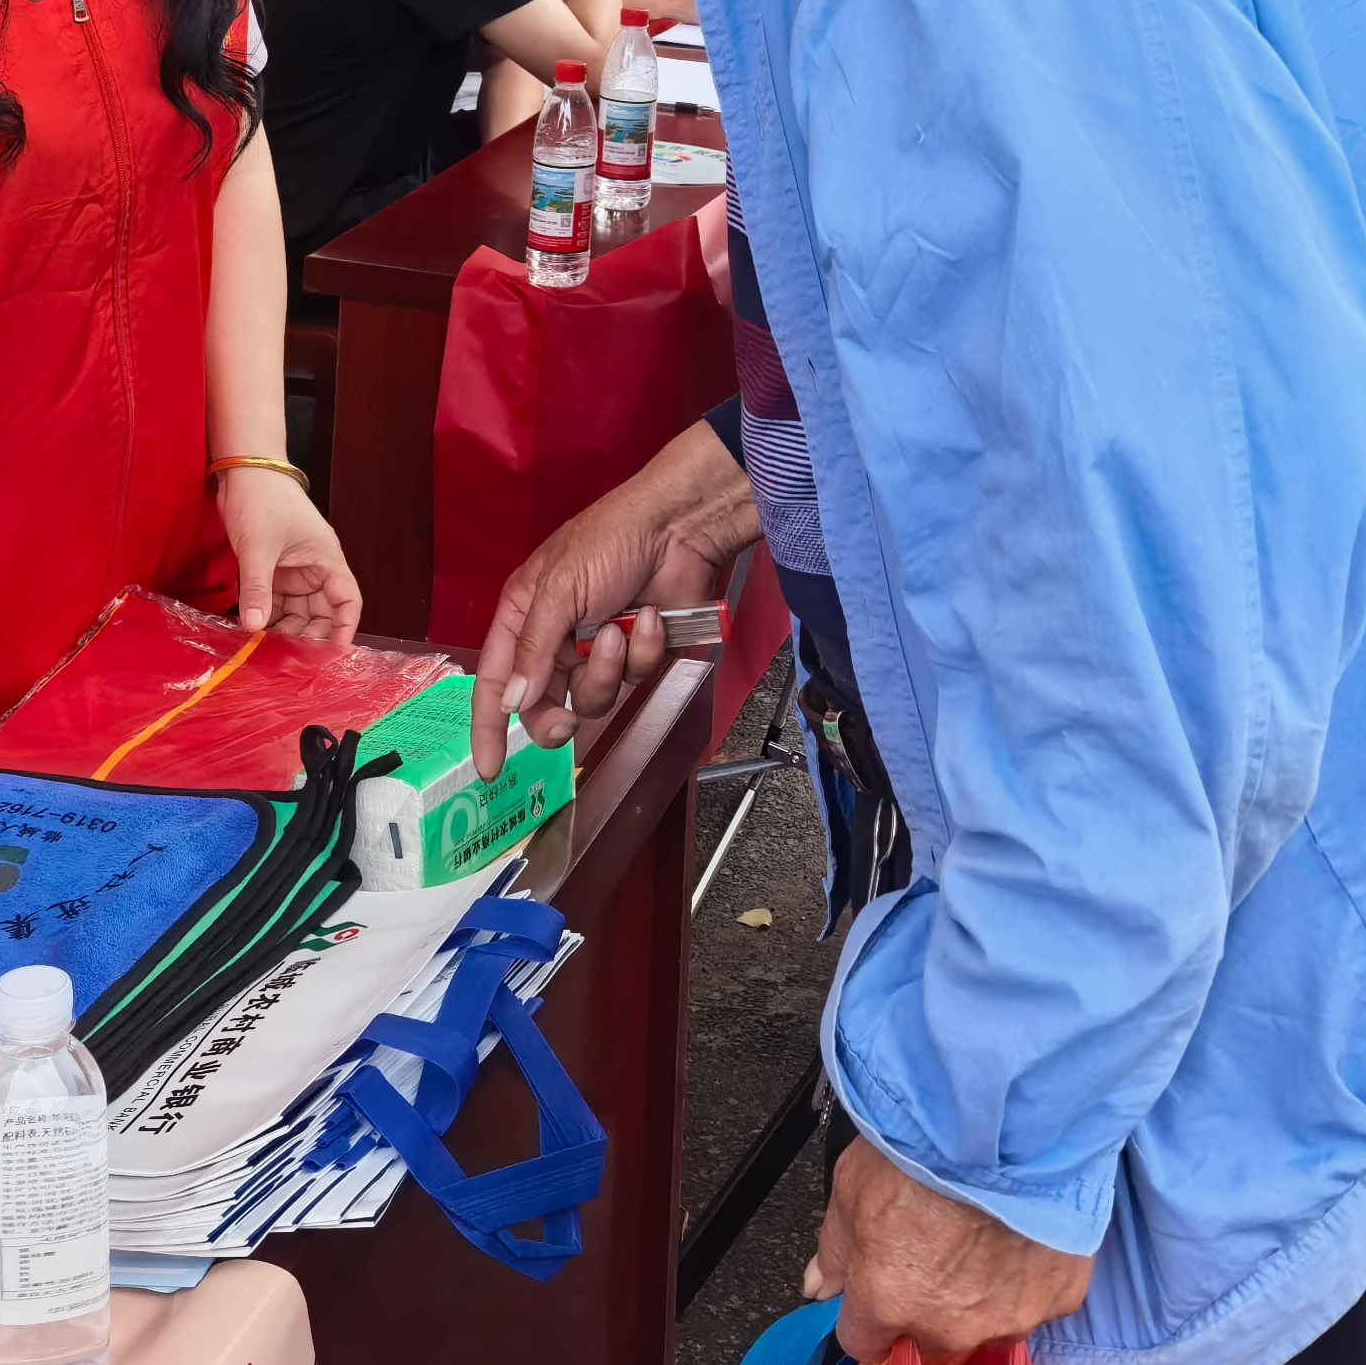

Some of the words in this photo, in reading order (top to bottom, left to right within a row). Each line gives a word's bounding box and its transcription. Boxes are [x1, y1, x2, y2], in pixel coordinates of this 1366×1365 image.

[131, 1035, 199, 1105] COMMERCIAL
[137, 957, 322, 1136] 临城农村商业银行
[108, 1107, 138, 1132] BANK
